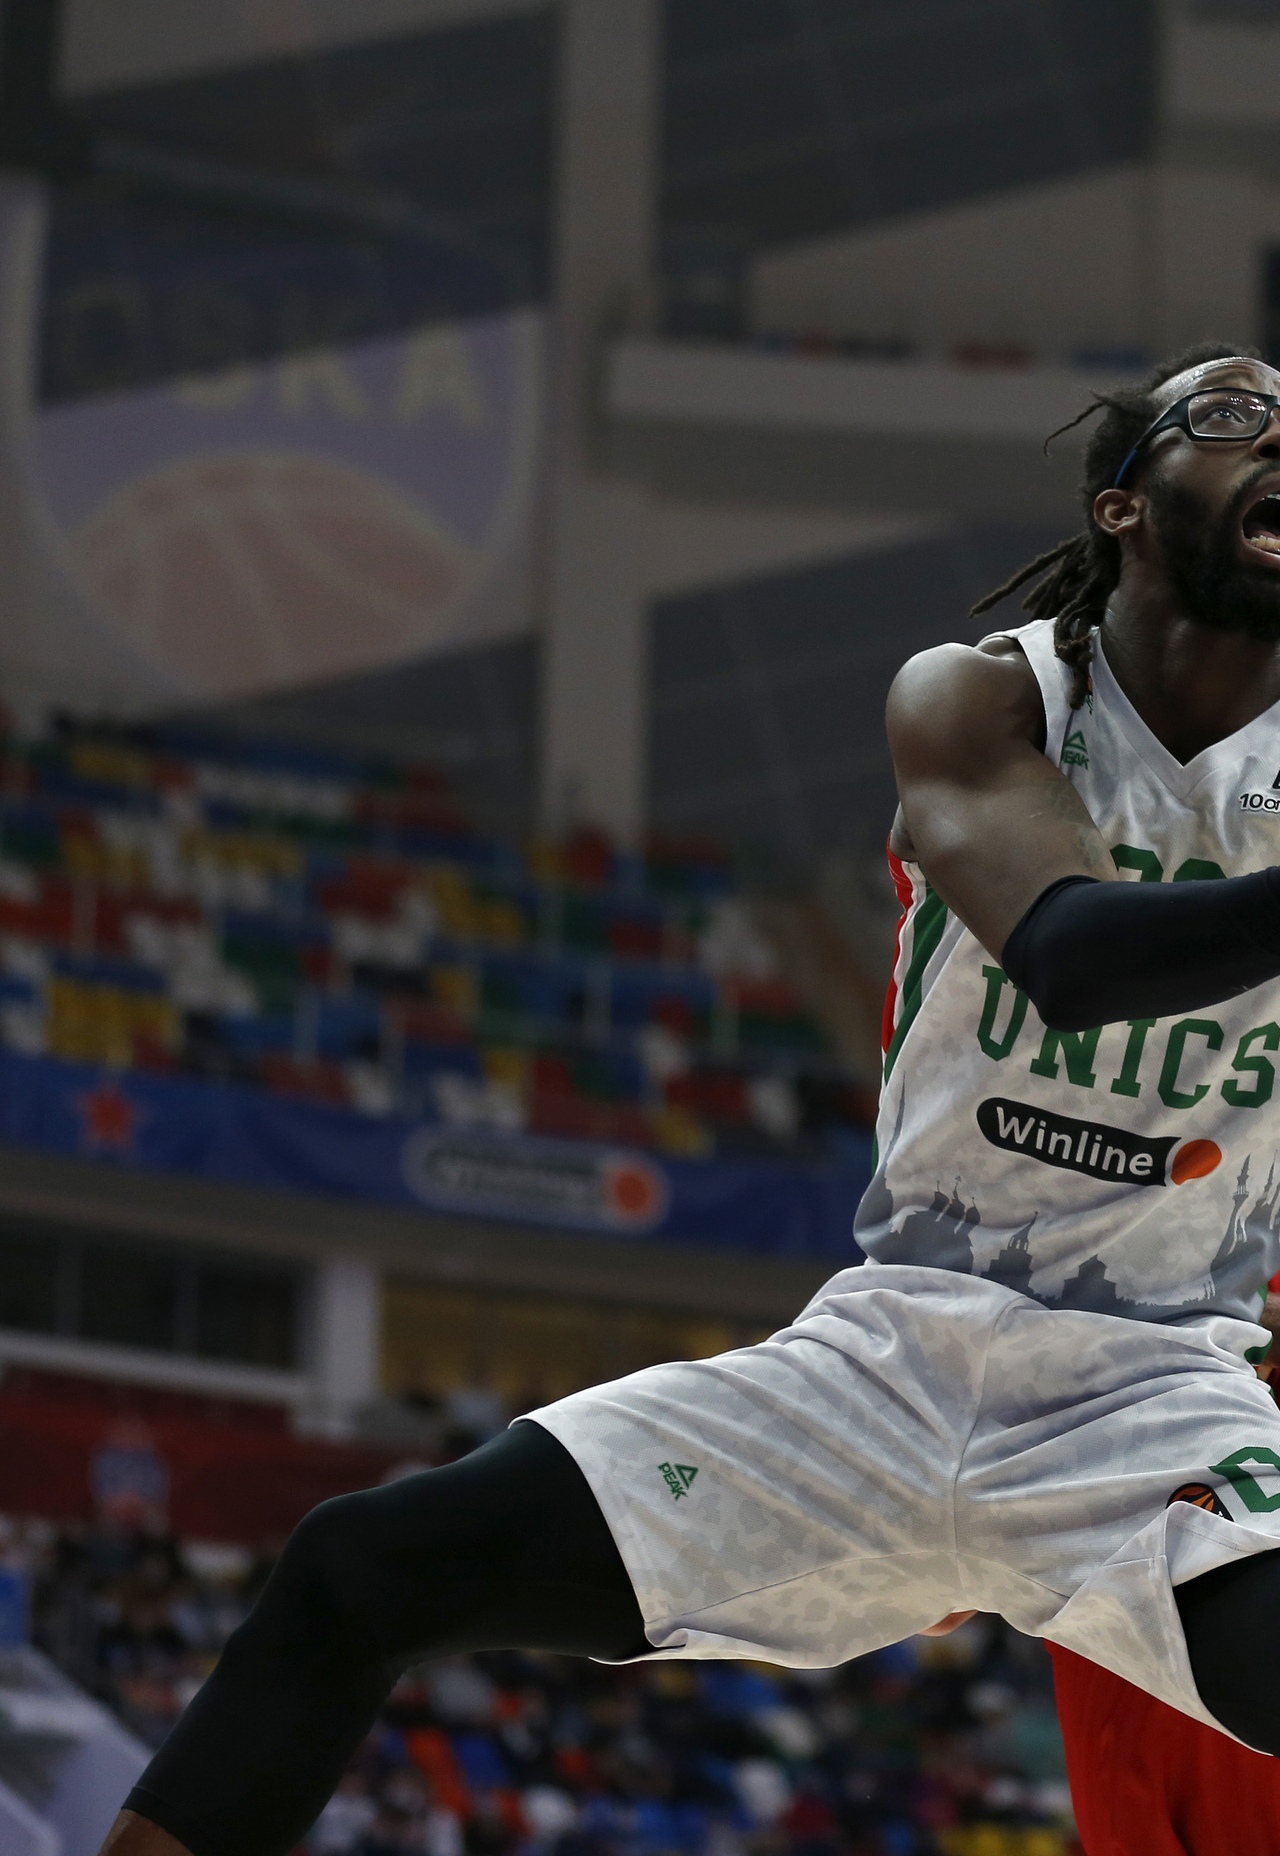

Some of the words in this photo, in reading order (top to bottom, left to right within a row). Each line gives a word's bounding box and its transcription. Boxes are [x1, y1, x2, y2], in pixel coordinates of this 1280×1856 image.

[1062, 750, 1089, 769] EAK
[996, 1106, 1153, 1176] Winline
[658, 1462, 688, 1501] PEAK
